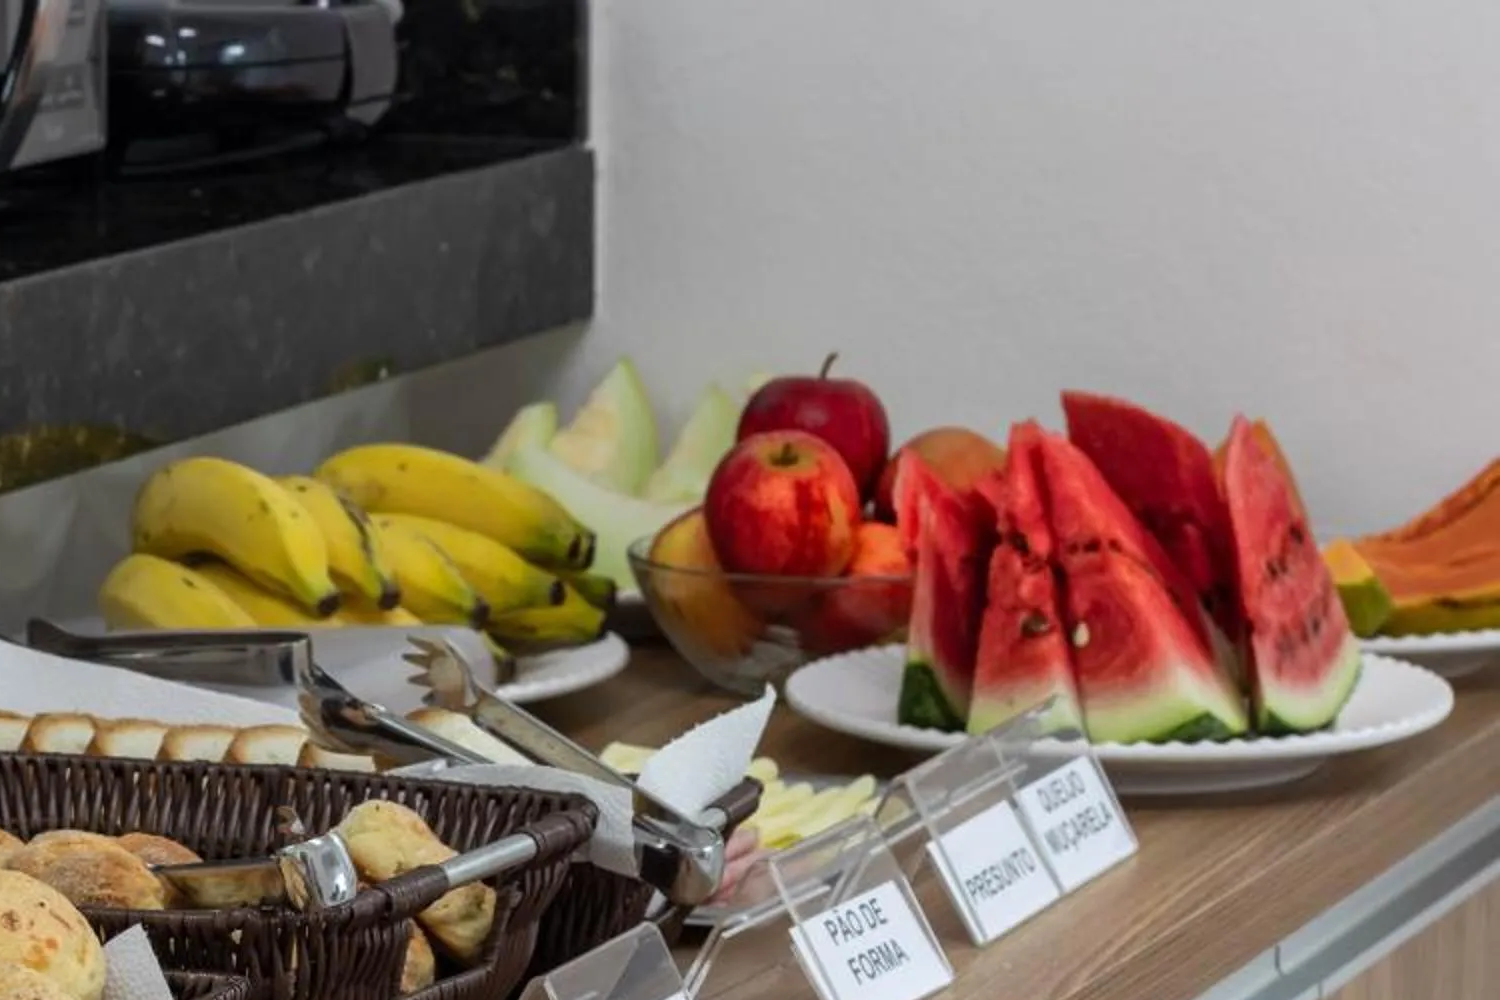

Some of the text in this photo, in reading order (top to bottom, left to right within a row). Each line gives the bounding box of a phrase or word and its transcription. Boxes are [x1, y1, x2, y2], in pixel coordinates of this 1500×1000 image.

[1036, 769, 1086, 814] QUEIJO
[1044, 803, 1113, 855] MUÇARELA
[964, 847, 1037, 902] PRESUNTO
[823, 898, 889, 947] PÃO DE
[847, 939, 910, 985] FORMA
